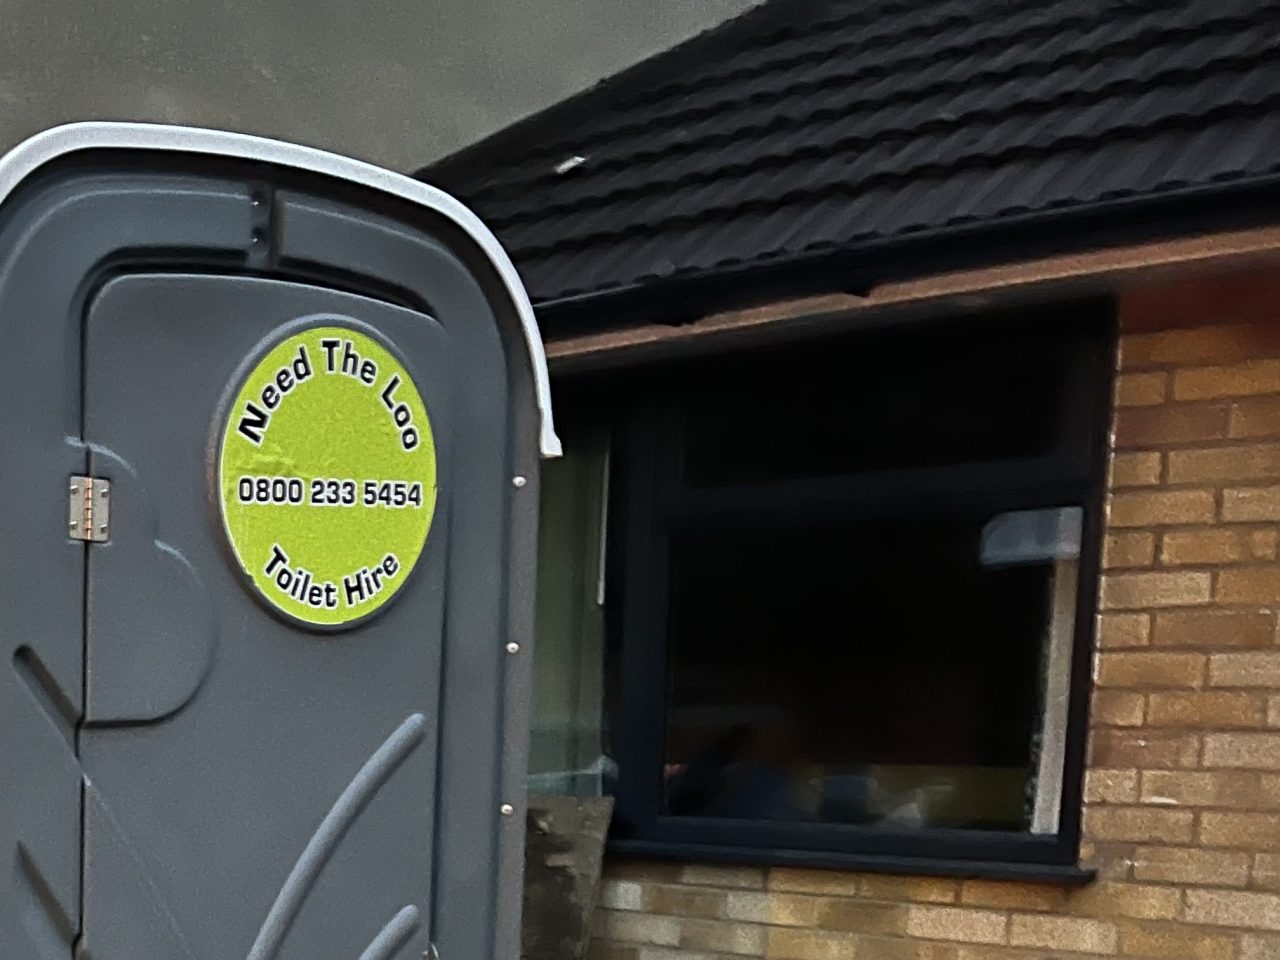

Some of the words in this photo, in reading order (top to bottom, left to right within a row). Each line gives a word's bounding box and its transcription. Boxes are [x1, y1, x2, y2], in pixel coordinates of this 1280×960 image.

[238, 347, 312, 443] Need
[322, 340, 377, 383] The
[381, 376, 419, 450] Loo
[239, 478, 303, 502] 0800
[311, 481, 355, 504] 233
[364, 483, 421, 506] 5454
[265, 545, 337, 607] Toilet
[344, 555, 399, 605] Hire
